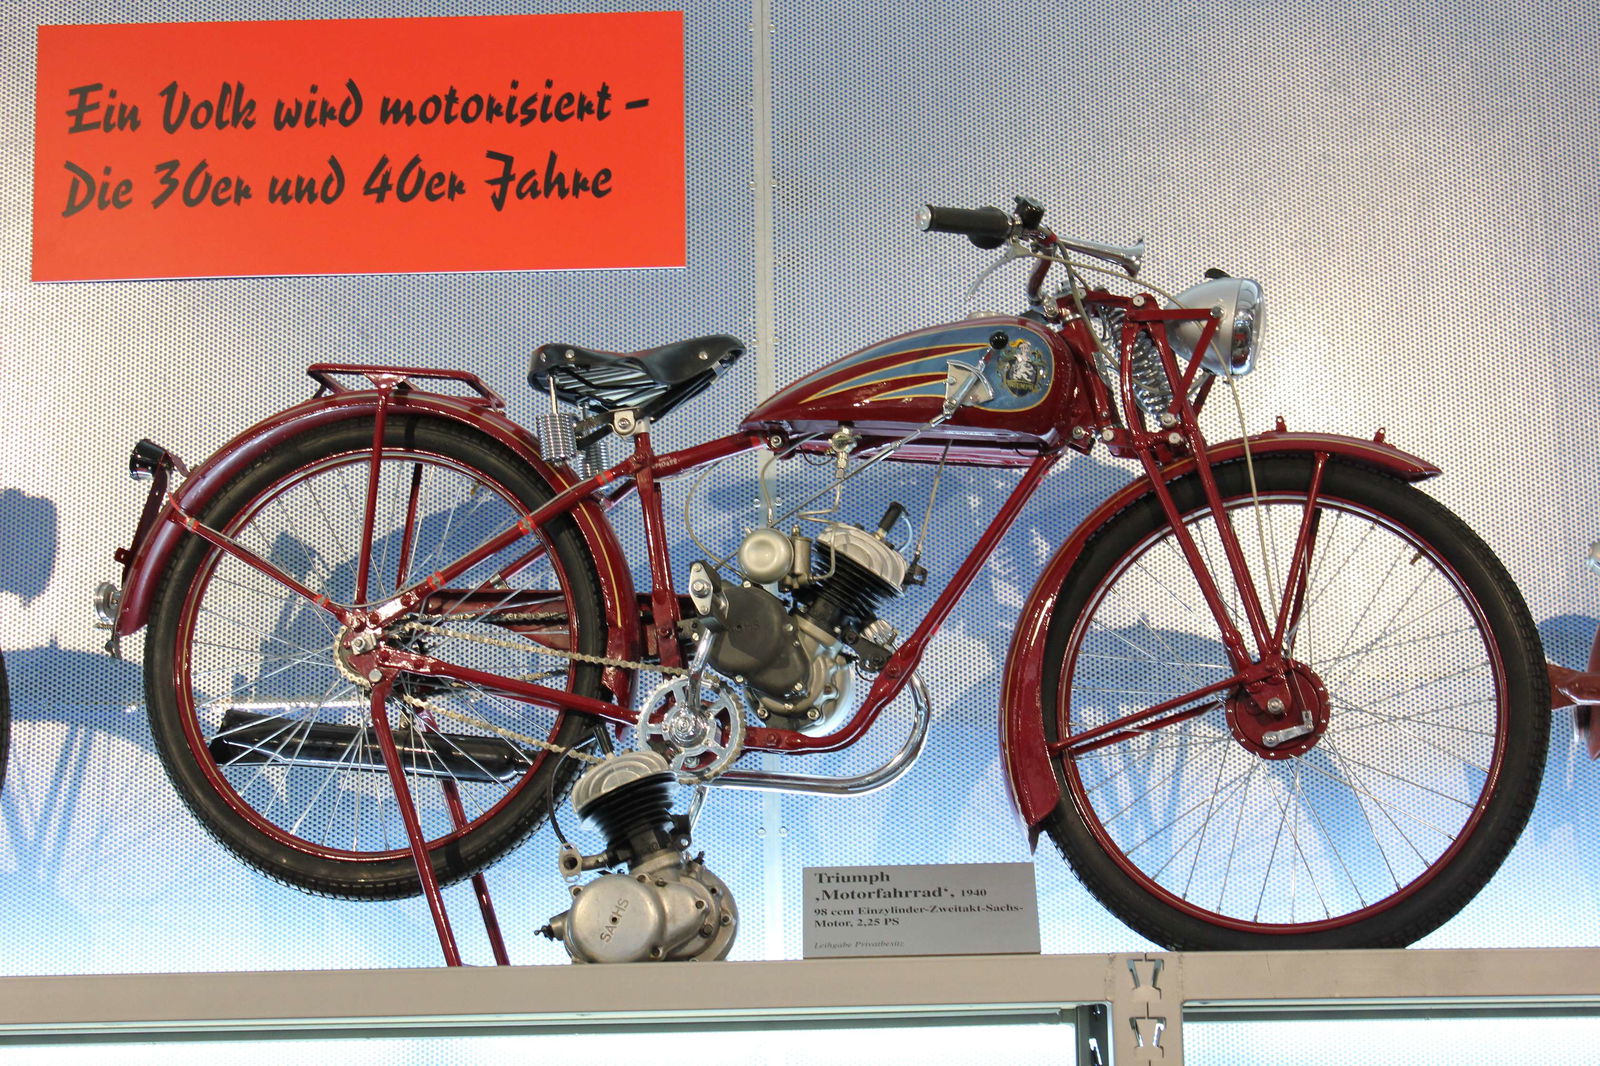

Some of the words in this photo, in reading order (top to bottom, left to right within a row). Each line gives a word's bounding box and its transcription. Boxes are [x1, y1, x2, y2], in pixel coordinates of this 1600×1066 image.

[66, 82, 142, 134] Ein
[159, 79, 257, 134] Volk
[273, 78, 364, 132] wird
[379, 79, 612, 127] motorisiert
[61, 160, 133, 218] Die
[151, 159, 252, 209] 30er
[268, 154, 346, 206] und
[362, 154, 466, 204] 40er
[484, 149, 613, 212] Jahre
[814, 871, 891, 885] Triumph
[961, 888, 987, 897] 1940
[813, 908, 828, 916] 98
[857, 904, 1024, 916] Einzylinder-Zweitakt-Sachs-
[814, 919, 854, 929] Motor,
[857, 918, 881, 928] 2,25
[884, 917, 900, 926] PS
[814, 942, 851, 950] Leihgabe
[855, 940, 904, 948] Privatbesitz
